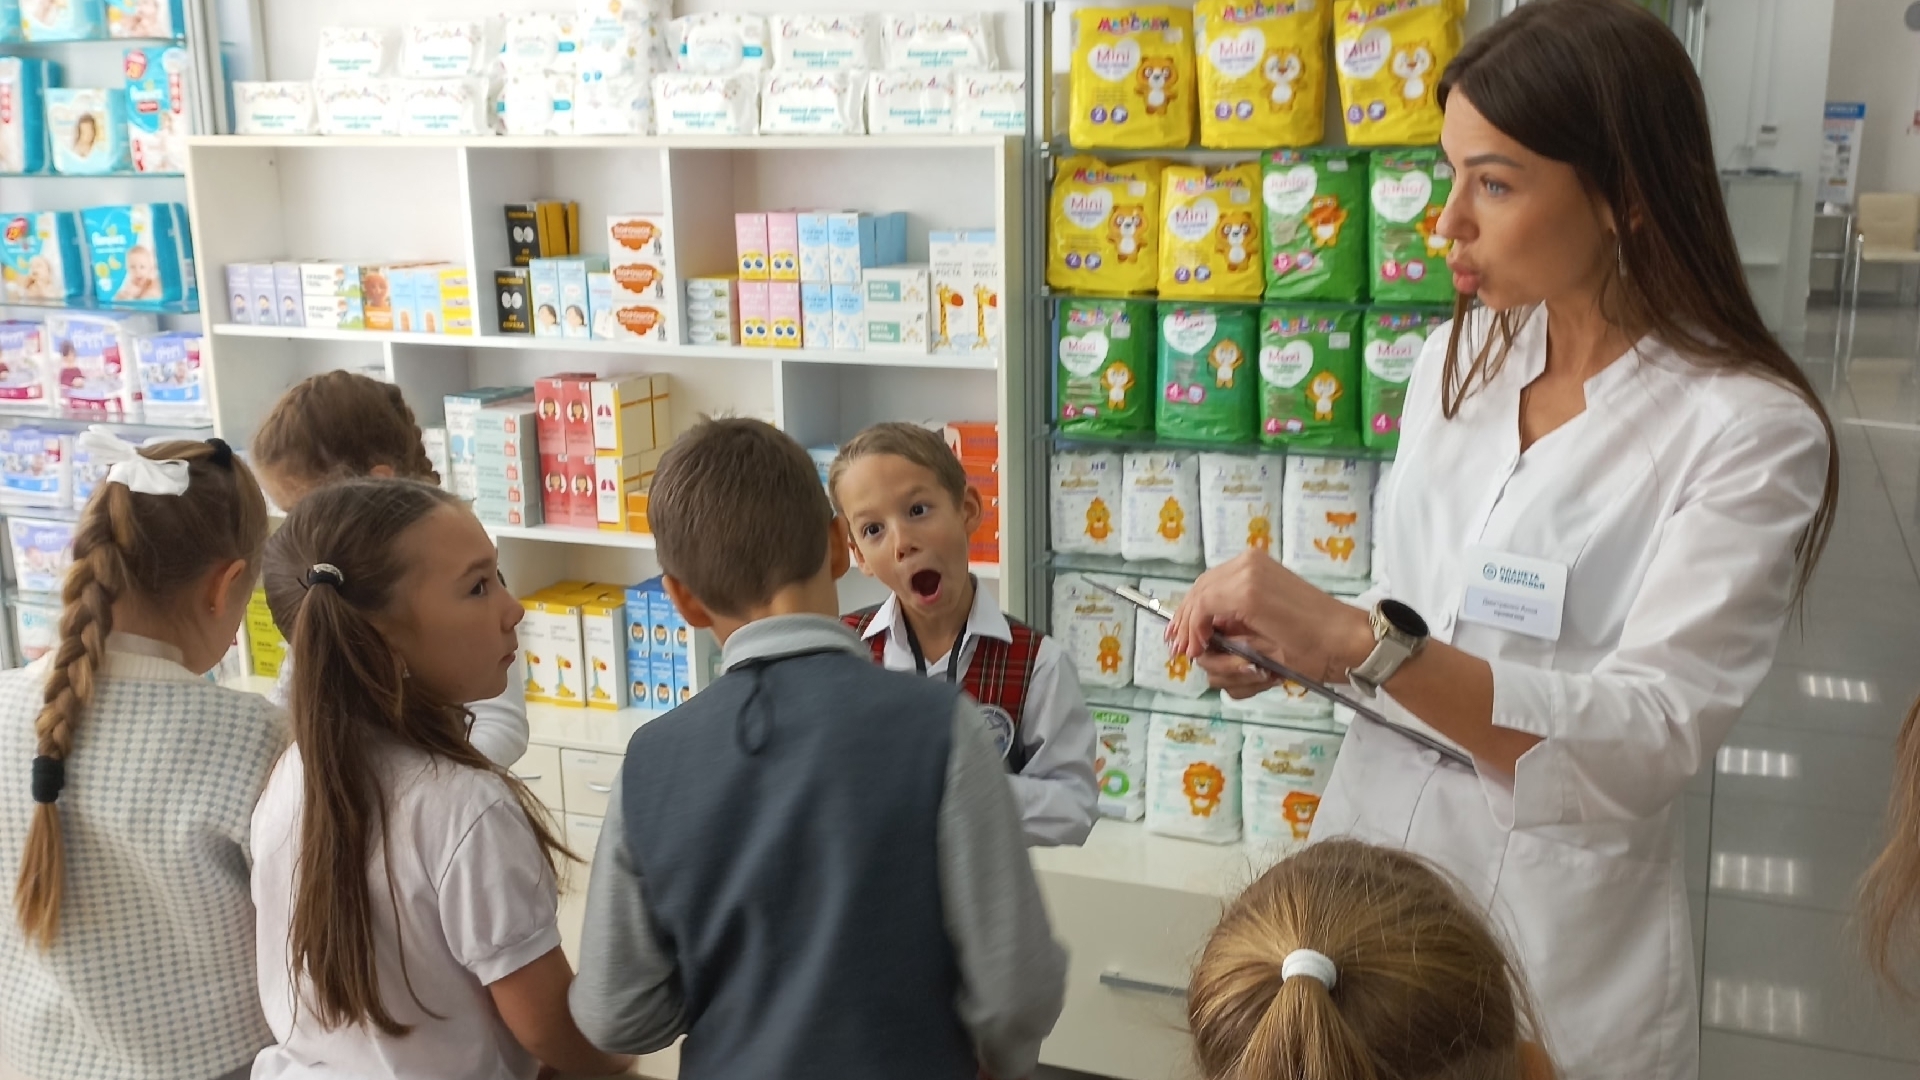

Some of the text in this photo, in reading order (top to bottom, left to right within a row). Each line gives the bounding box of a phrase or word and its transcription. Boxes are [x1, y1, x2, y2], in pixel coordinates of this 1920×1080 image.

[1219, 40, 1256, 55] Midi
[1097, 49, 1130, 63] Mini
[1380, 182, 1425, 198] Junior
[1071, 197, 1103, 210] Mini
[1175, 208, 1208, 222] Mini
[1069, 254, 1078, 267] 2
[1178, 268, 1187, 281] 2
[1068, 340, 1097, 352] Maxi
[1377, 344, 1412, 357] Maxi
[1269, 350, 1301, 363] Maxi
[1267, 418, 1277, 433] 4
[1375, 414, 1387, 430] 4
[1499, 566, 1540, 582] ПЛАНЕТА
[1499, 576, 1545, 590] ЗДОРОВЬЯ
[1309, 744, 1326, 758] XL
